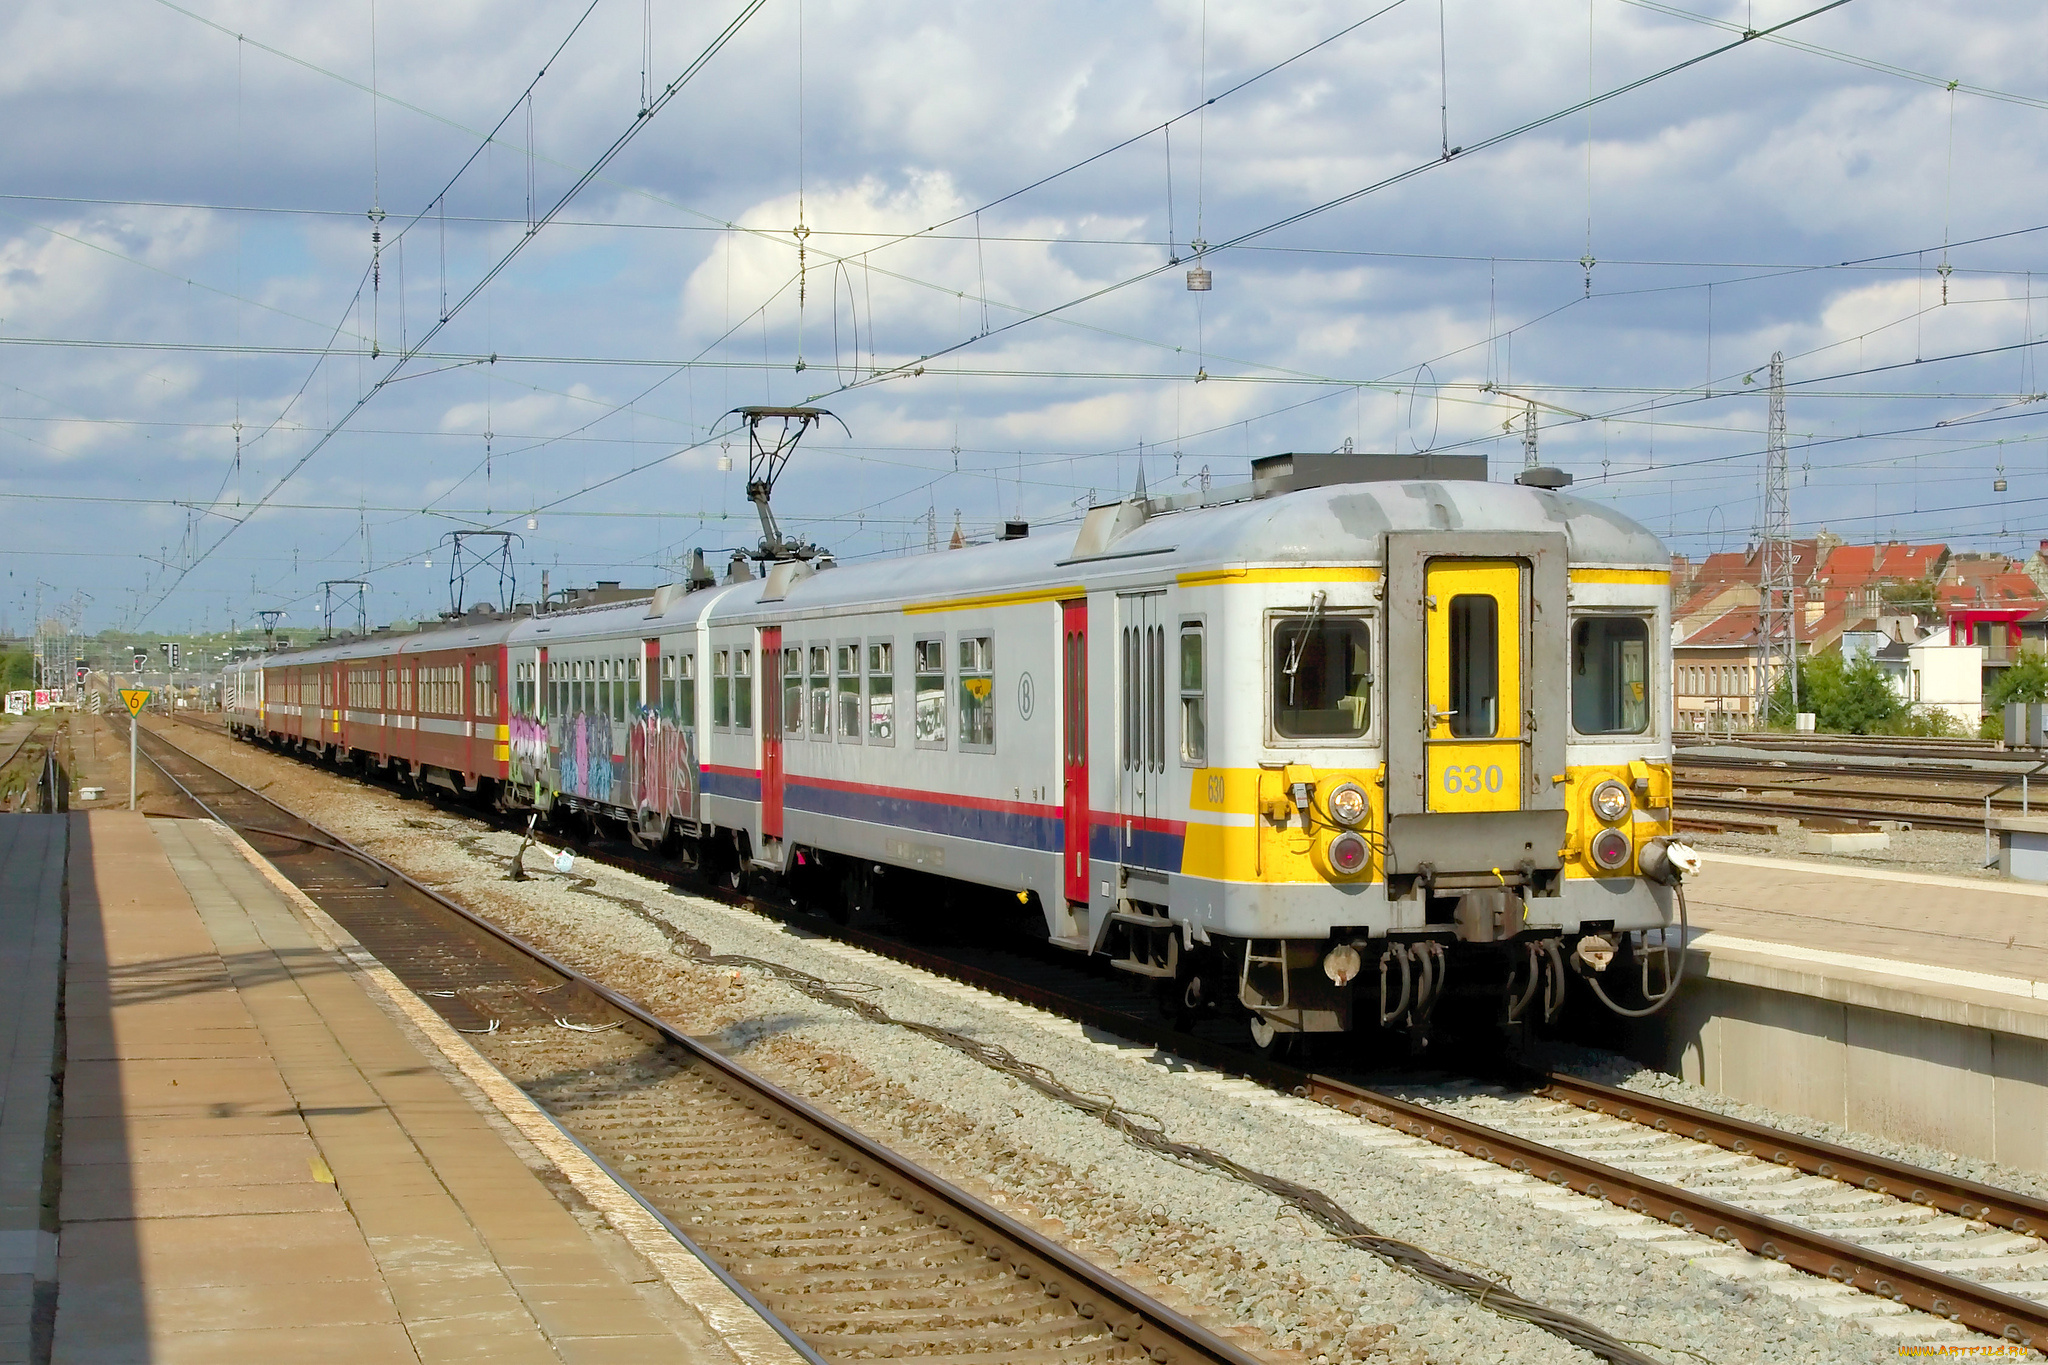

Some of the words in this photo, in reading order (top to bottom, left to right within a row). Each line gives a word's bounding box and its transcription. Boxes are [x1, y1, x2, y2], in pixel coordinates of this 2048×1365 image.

[130, 691, 140, 709] 6
[1207, 775, 1225, 804] 630
[1443, 764, 1504, 794] 630
